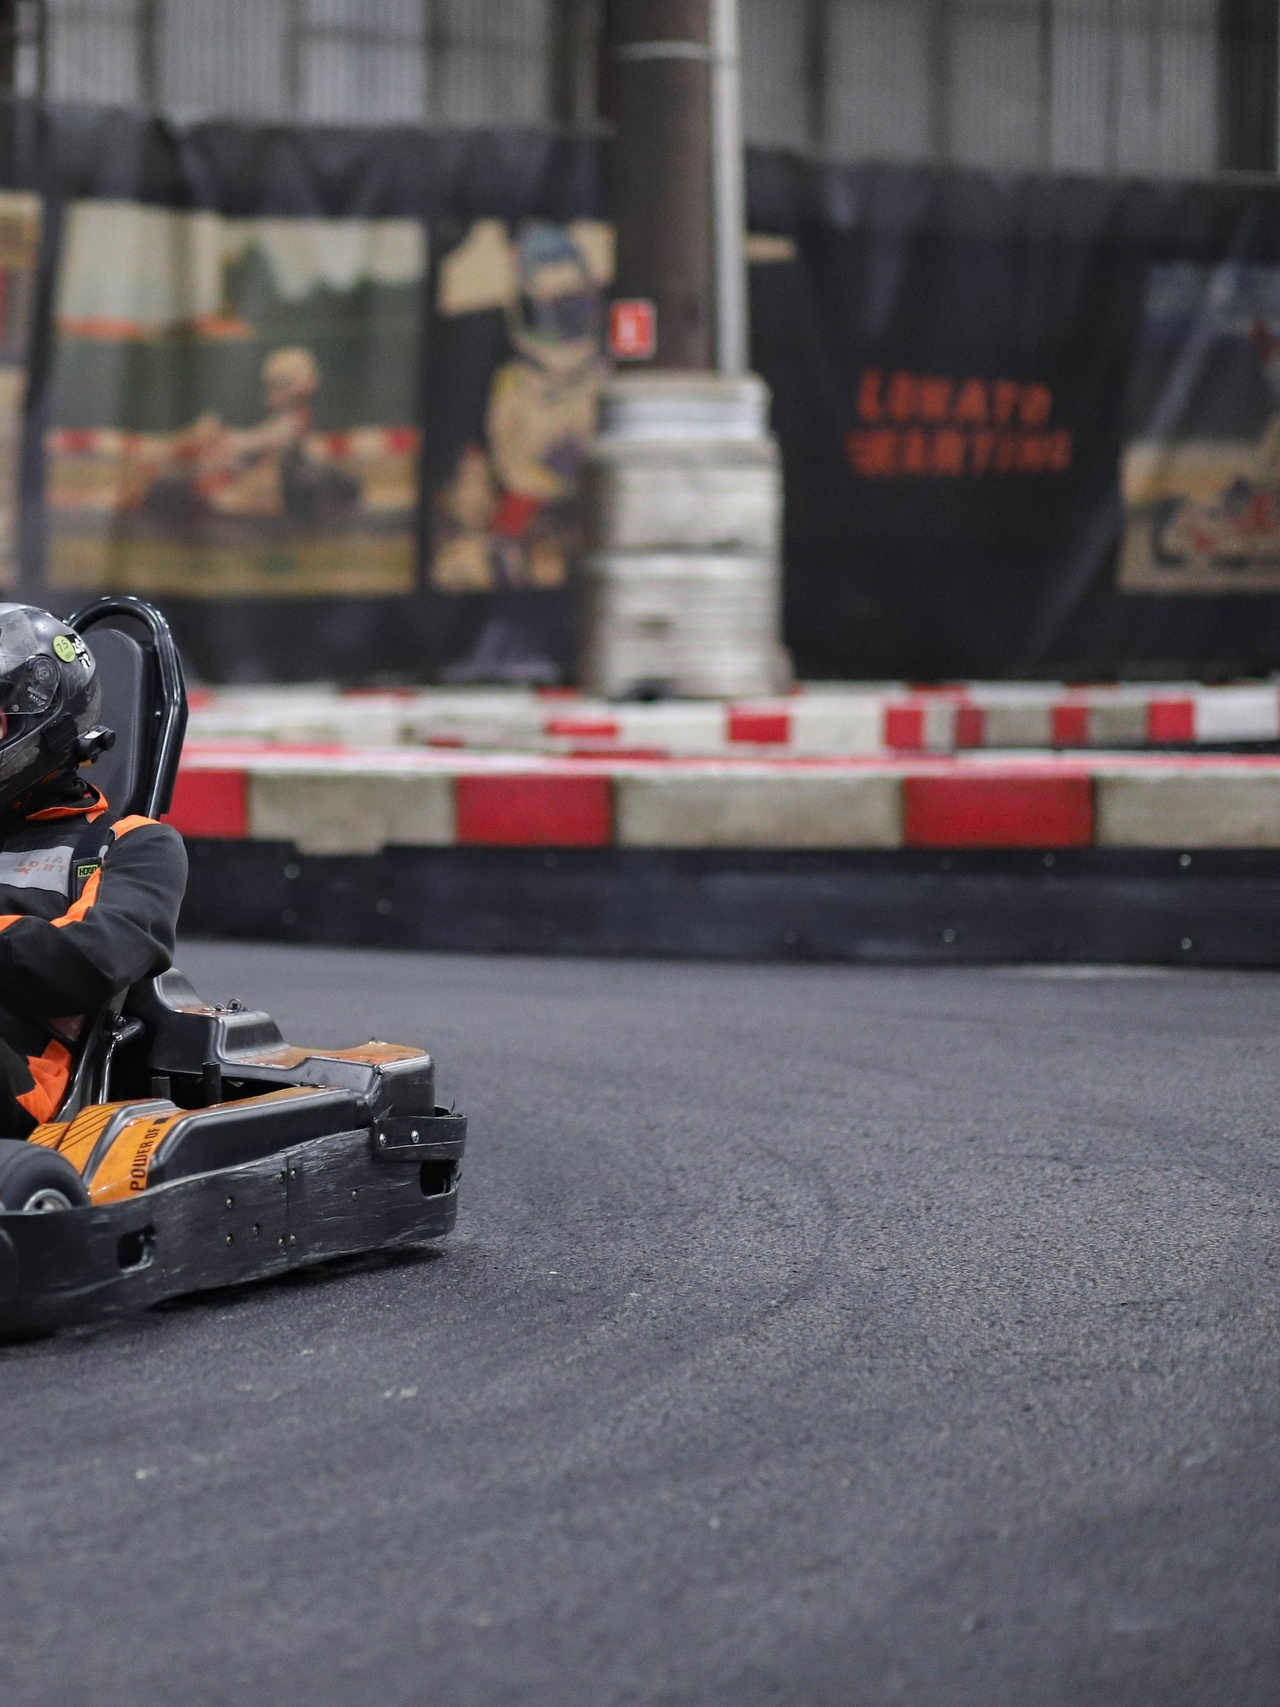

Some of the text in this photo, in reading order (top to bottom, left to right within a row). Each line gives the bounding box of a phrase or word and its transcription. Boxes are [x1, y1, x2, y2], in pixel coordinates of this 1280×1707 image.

[856, 368, 1052, 426] LONATO
[130, 1128, 160, 1191] POWER OF
